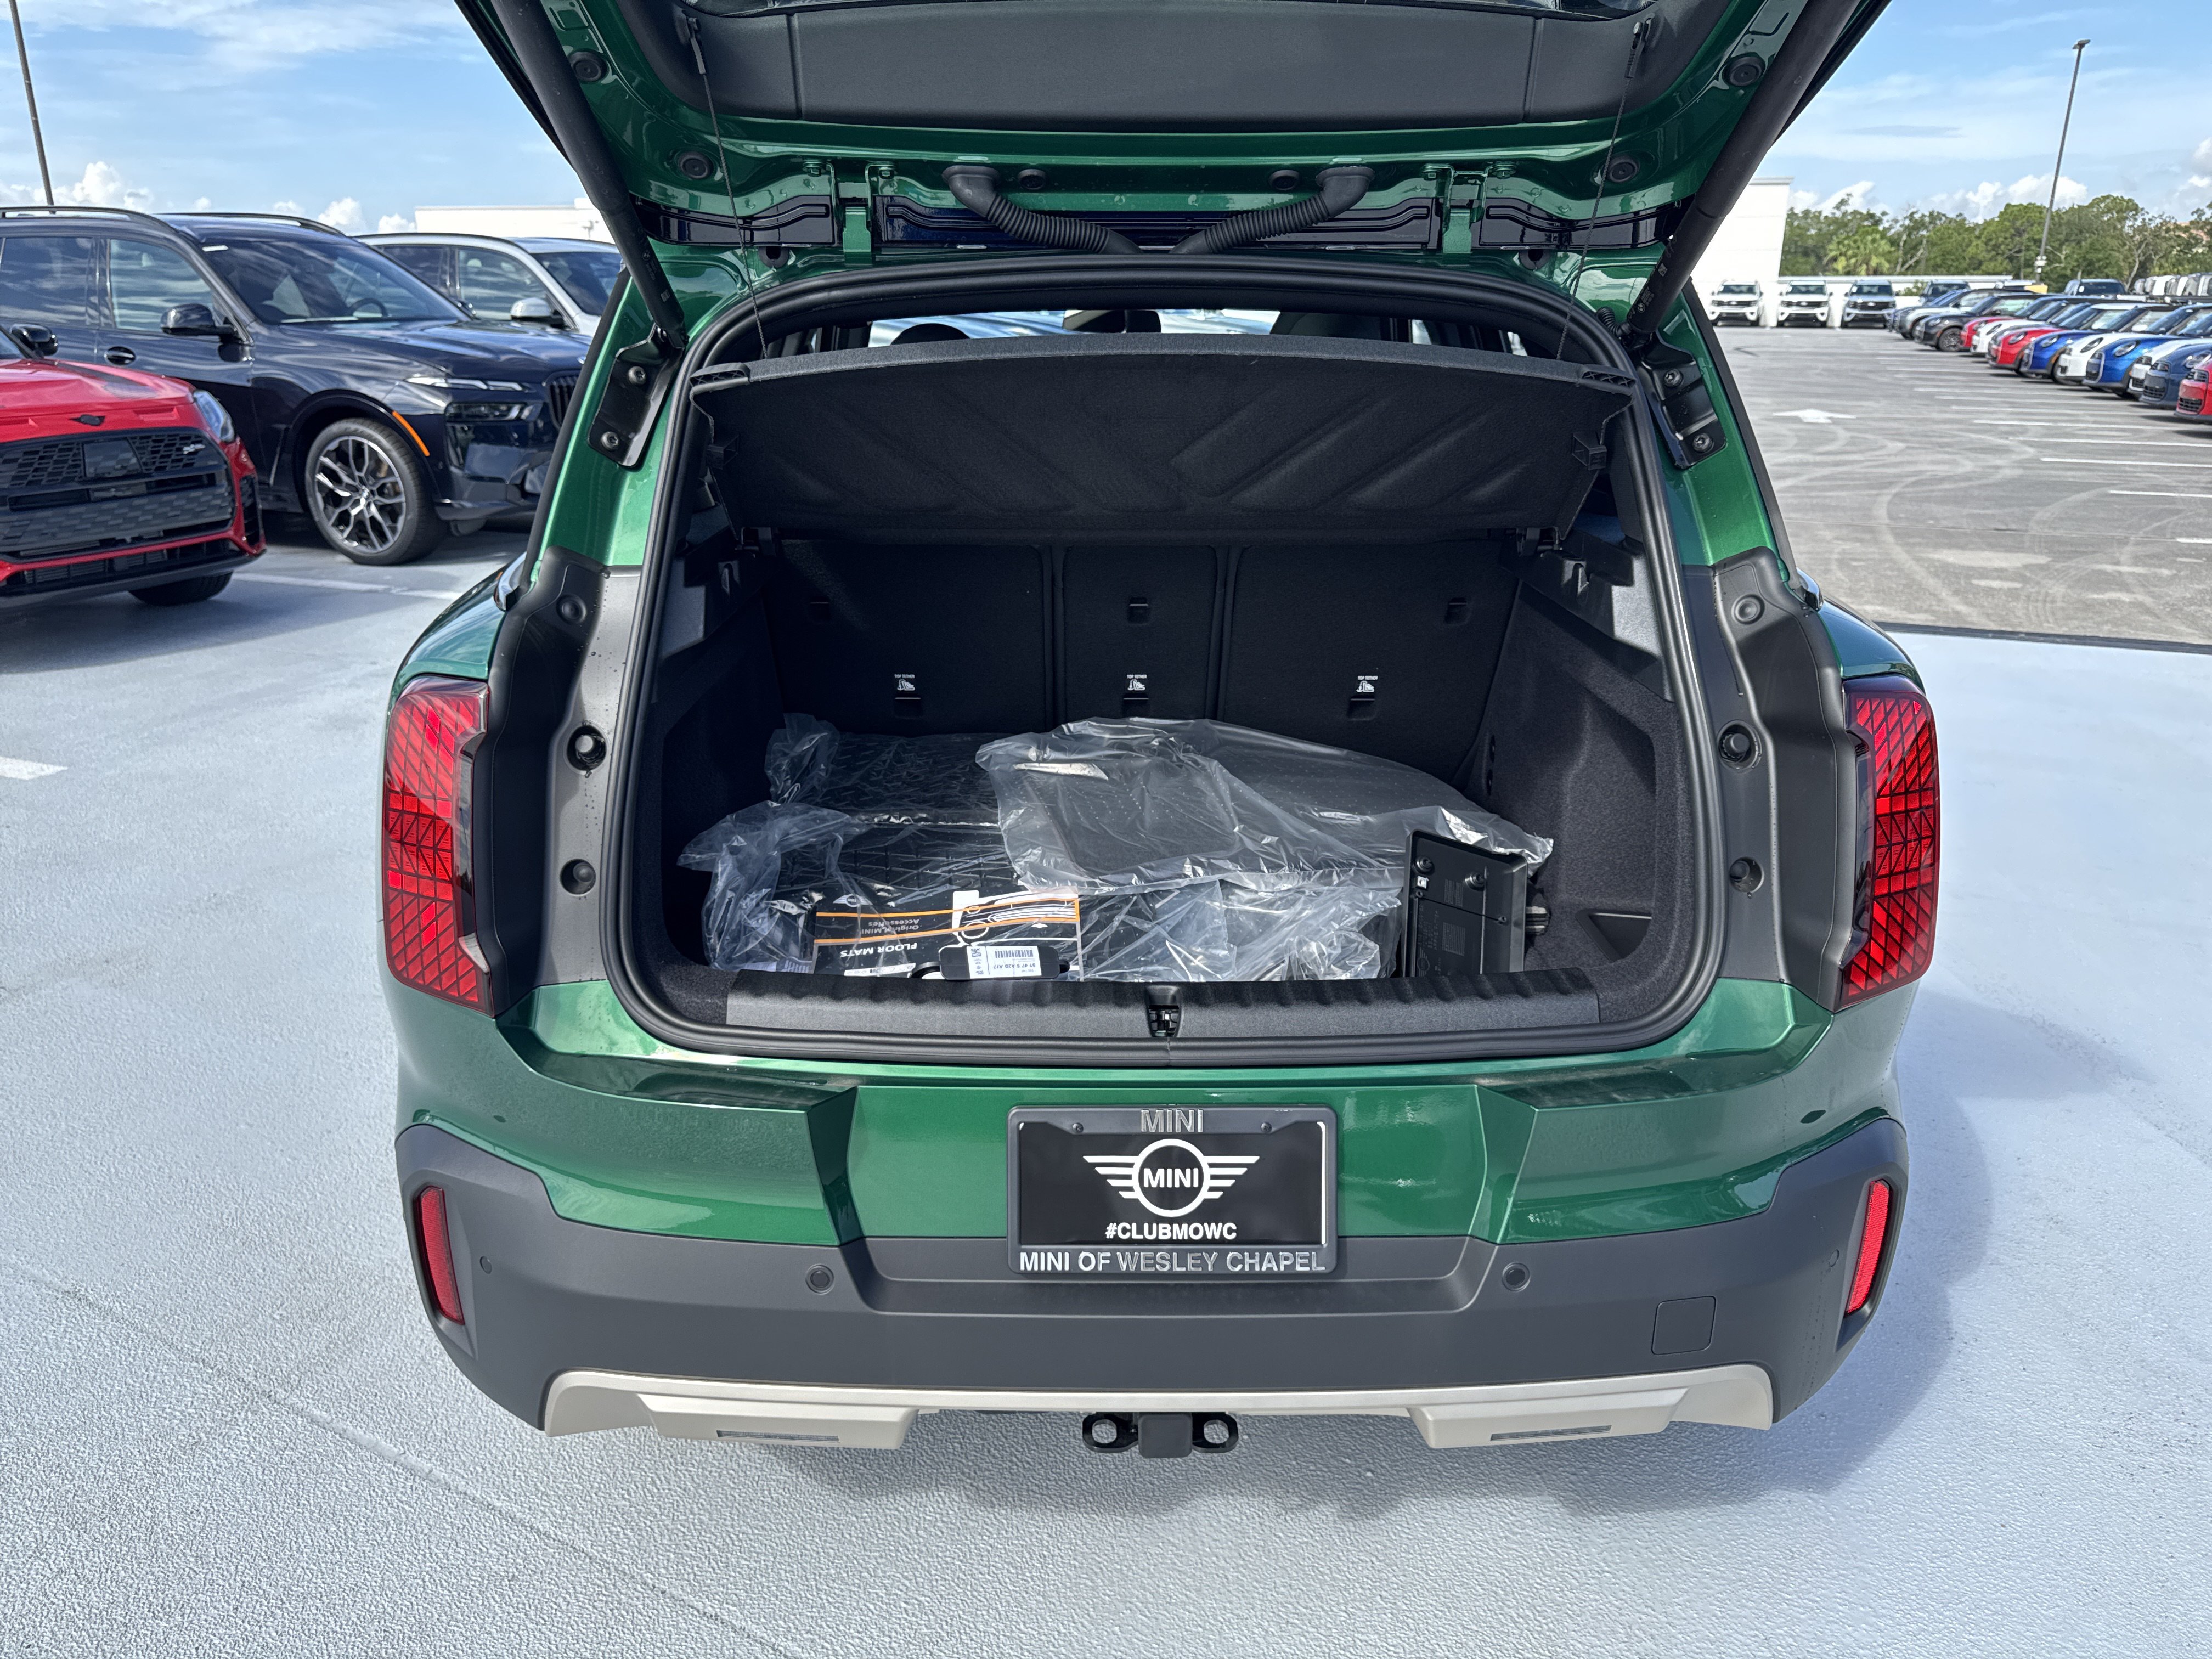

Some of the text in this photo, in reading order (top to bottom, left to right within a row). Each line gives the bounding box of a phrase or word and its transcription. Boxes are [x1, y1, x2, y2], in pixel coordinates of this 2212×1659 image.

[840, 942, 917, 957] FLOOR MATS
[1141, 1109, 1204, 1133] MINI
[1143, 1168, 1199, 1188] MINI
[1105, 1222, 1237, 1240] #CLUBMOWC
[1020, 1251, 1325, 1272] MINI OF WESLEY CHAPEL
